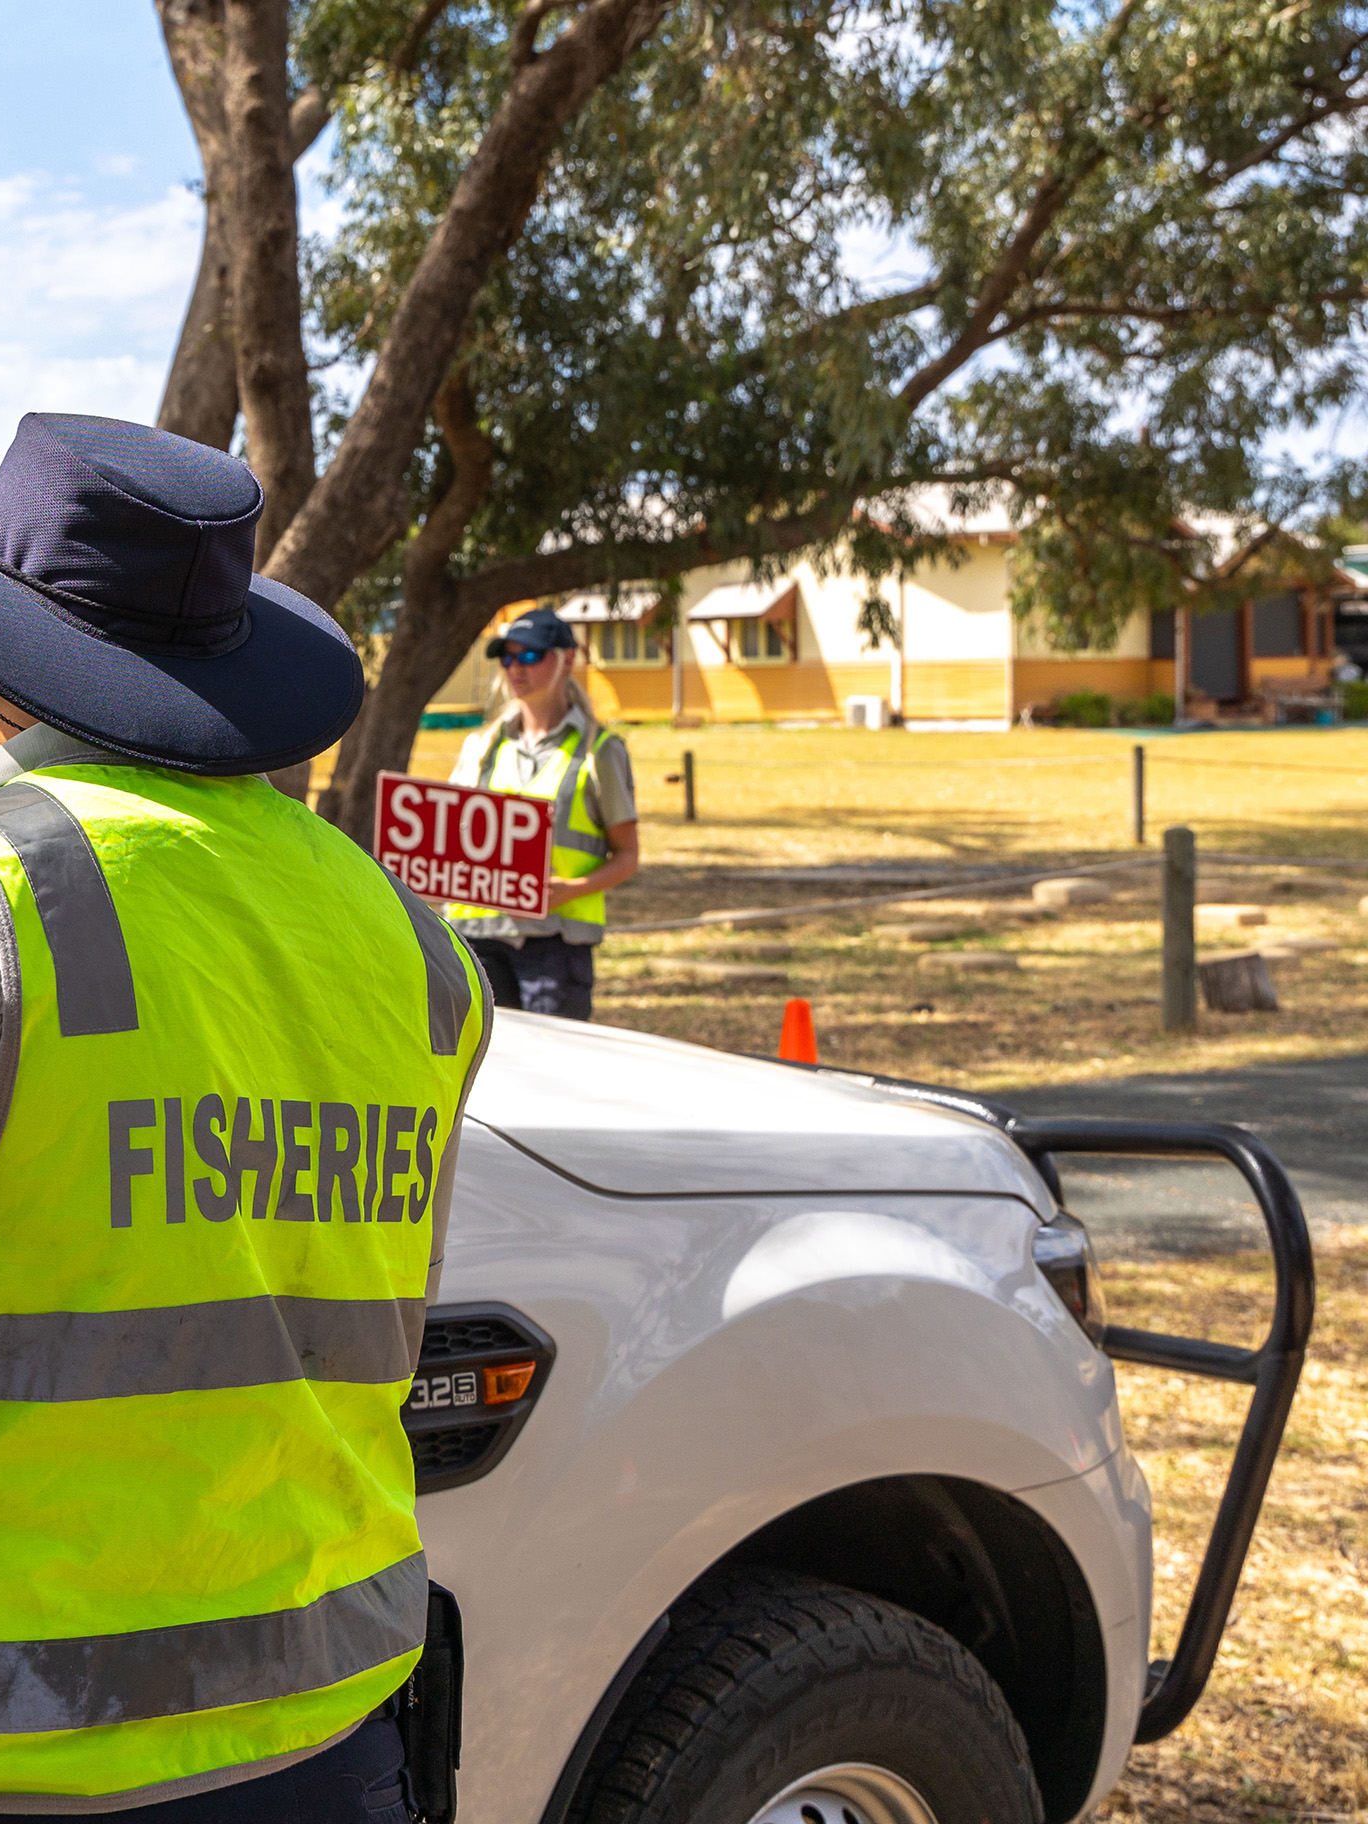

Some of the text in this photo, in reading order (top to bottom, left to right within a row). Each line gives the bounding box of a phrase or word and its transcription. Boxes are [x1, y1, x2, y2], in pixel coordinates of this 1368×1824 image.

[387, 783, 541, 866] STOP
[383, 851, 540, 910] FISHERIES
[108, 1093, 438, 1228] FISHERIES
